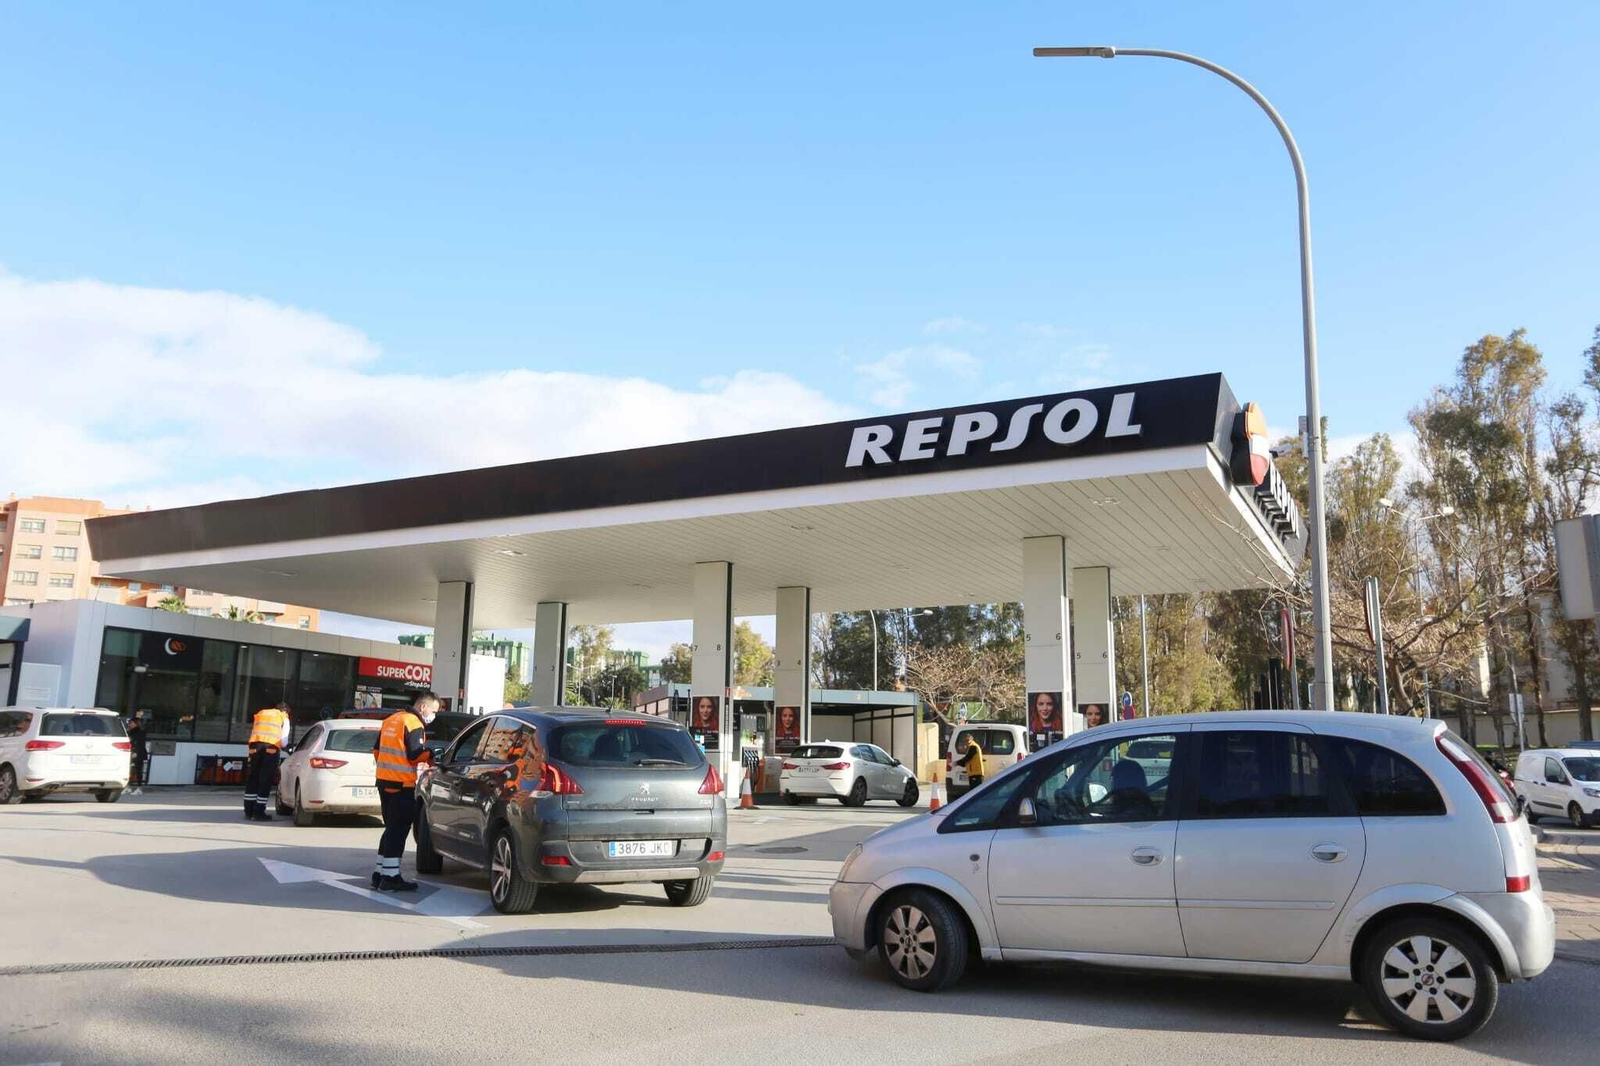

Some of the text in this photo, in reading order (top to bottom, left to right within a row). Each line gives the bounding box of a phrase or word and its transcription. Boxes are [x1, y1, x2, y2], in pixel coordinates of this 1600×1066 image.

[845, 391, 1143, 468] REPSOL
[1026, 633, 1061, 642] 5 6
[1076, 652, 1081, 660] 5
[377, 665, 431, 682] SUPERCOR
[618, 842, 646, 854] 3876
